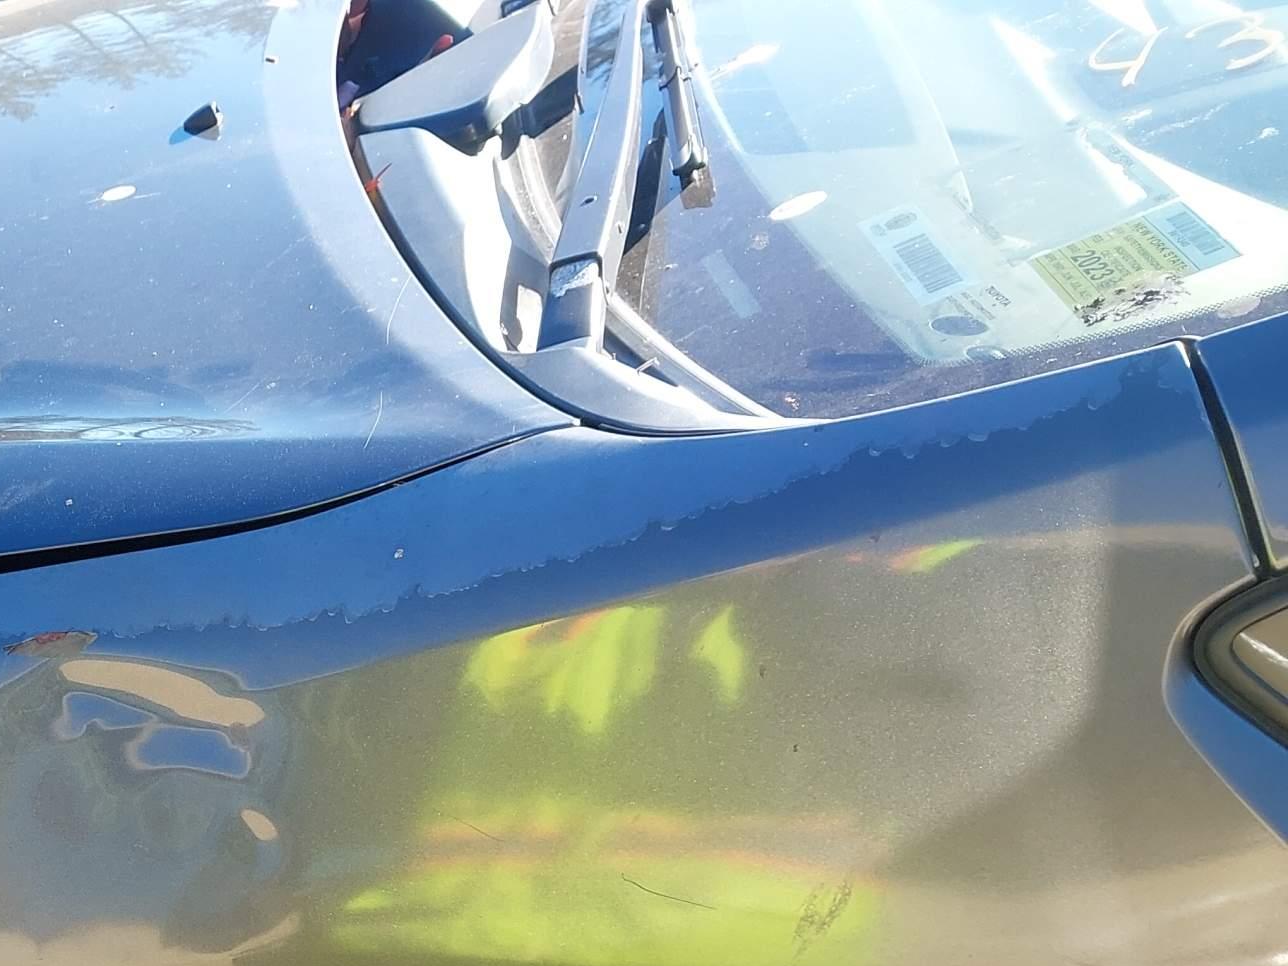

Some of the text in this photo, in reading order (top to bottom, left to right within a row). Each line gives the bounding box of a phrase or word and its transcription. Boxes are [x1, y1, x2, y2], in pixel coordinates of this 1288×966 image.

[1146, 236, 1169, 254] YORK
[1070, 249, 1115, 282] 2023
[985, 285, 1012, 308] TOYOTA
